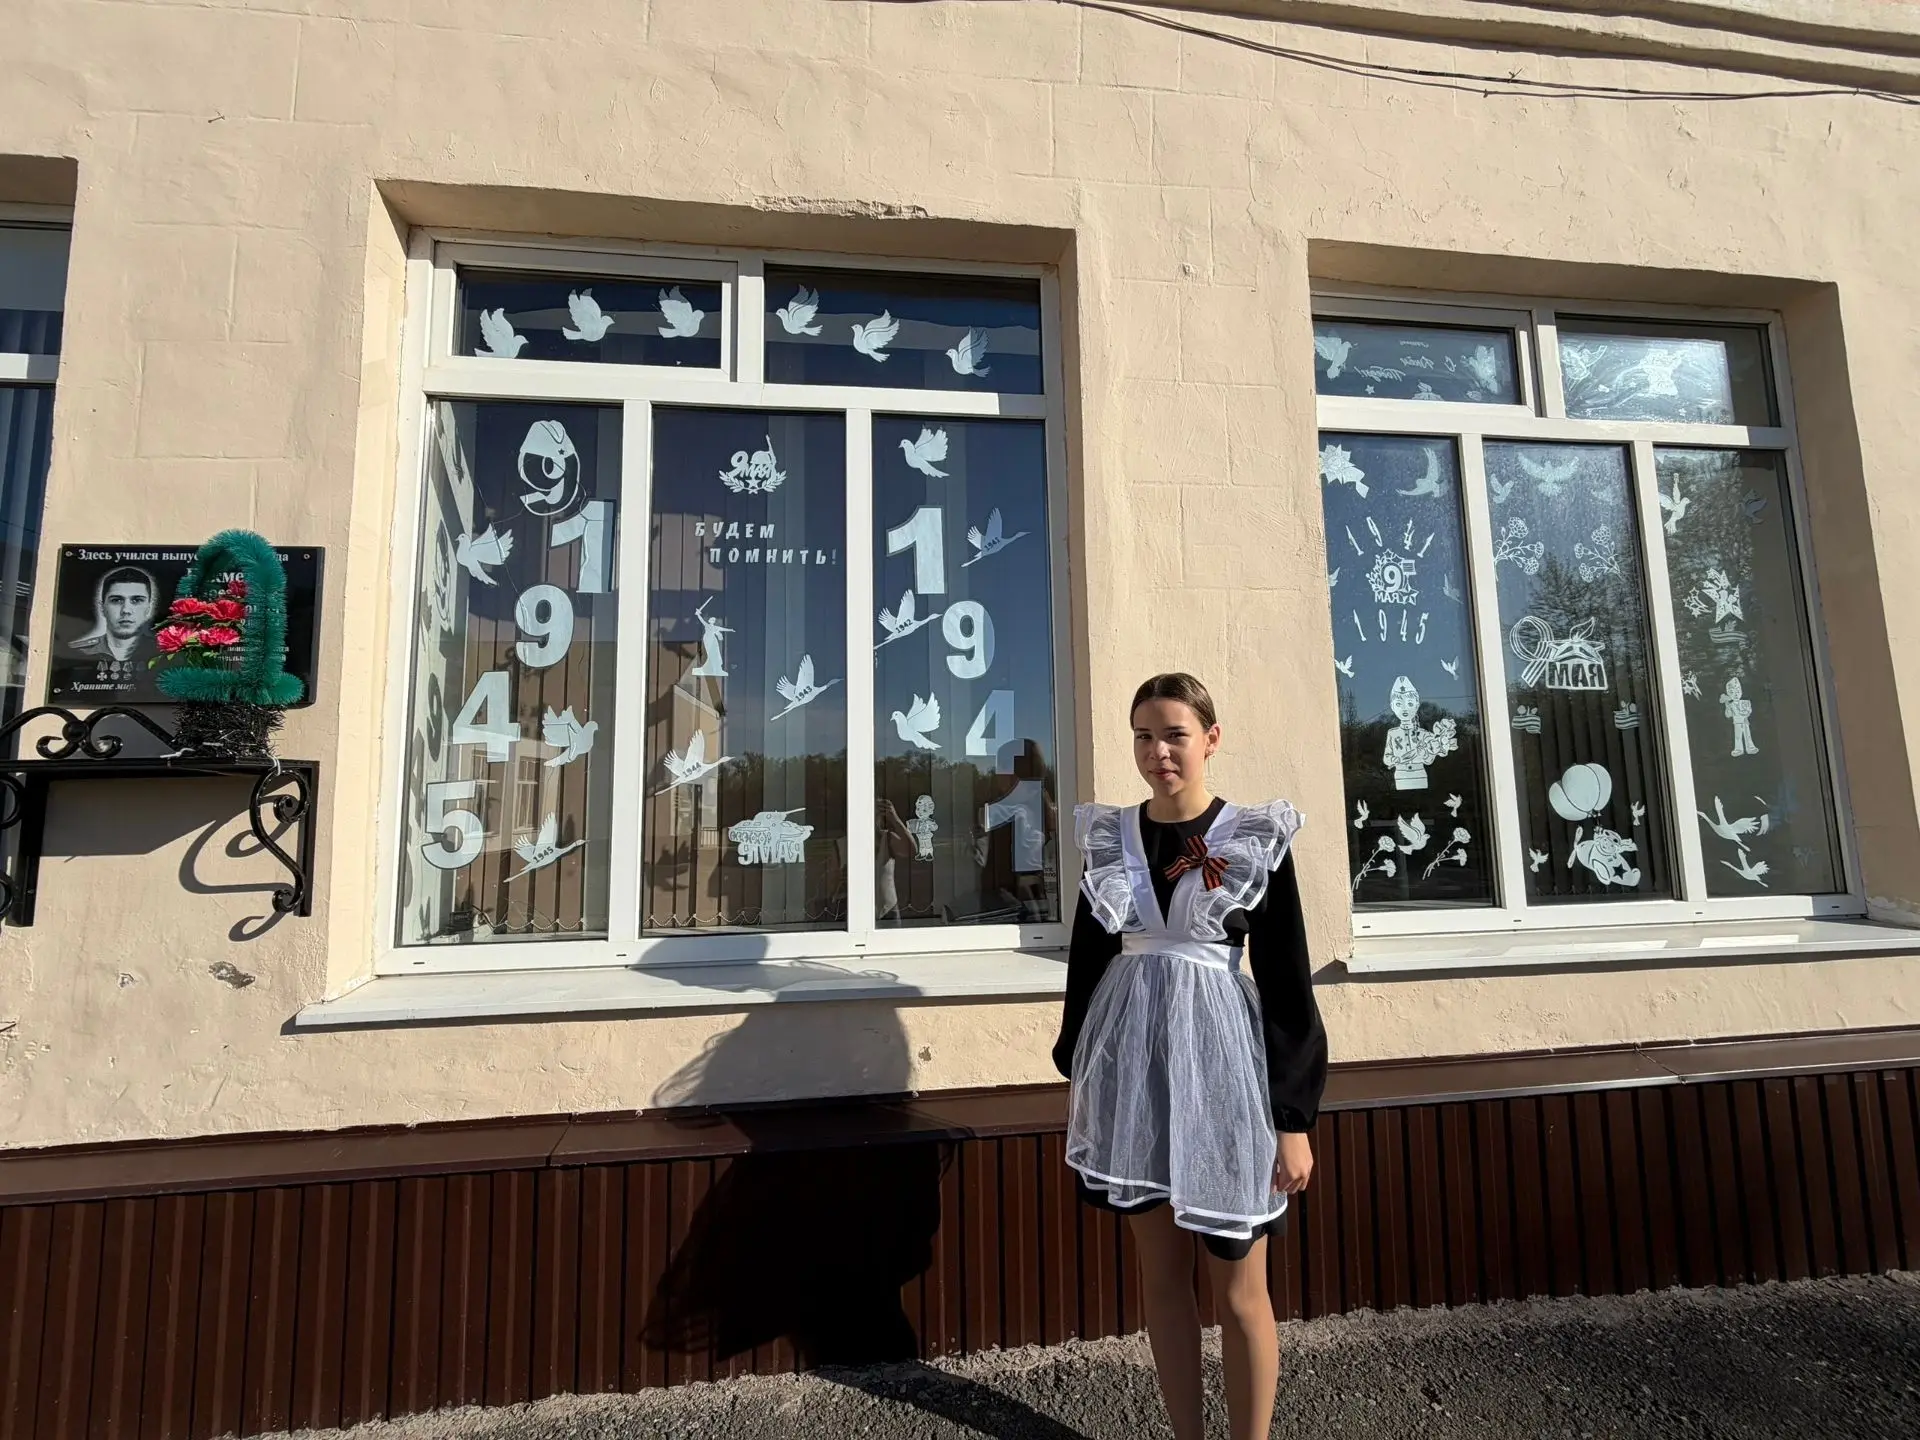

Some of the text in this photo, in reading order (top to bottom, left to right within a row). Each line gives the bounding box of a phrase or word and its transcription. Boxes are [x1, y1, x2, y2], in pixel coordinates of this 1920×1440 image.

[694, 521, 775, 540] БУДЕМ
[78, 549, 112, 561] Здесь
[115, 552, 159, 563] учился
[709, 547, 837, 566] ПОМНИТЬ!
[1383, 564, 1402, 594] 9
[1547, 660, 1605, 688] МАЯ
[70, 681, 115, 693] Храните
[795, 685, 813, 702] 1943
[532, 846, 555, 864] 1945
